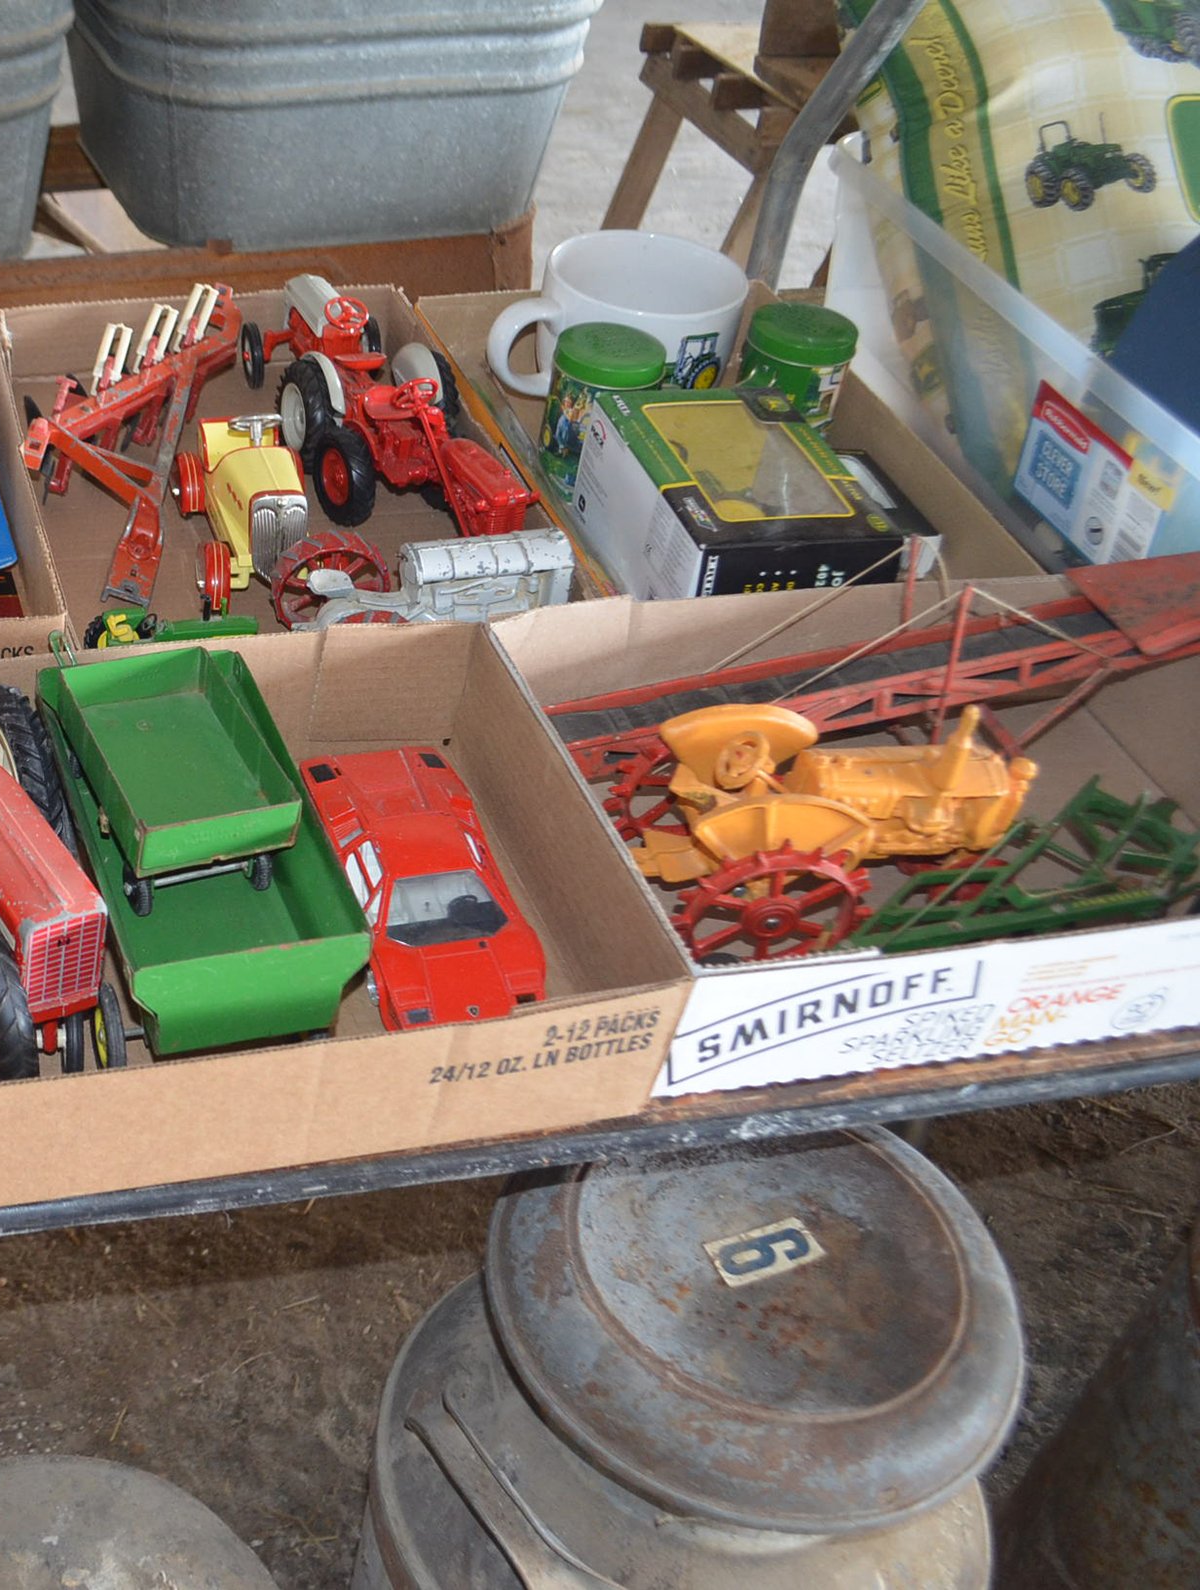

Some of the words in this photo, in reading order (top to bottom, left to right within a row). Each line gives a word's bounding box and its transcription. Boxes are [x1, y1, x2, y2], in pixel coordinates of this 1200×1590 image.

[944, 117, 964, 139] a
[939, 143, 977, 205] Like
[961, 209, 988, 263] uns
[1041, 440, 1074, 476] CLEVER
[1034, 462, 1068, 499] STORE
[697, 966, 953, 1063] SMIRNOFF
[1007, 983, 1126, 1014] ORANGE
[543, 1018, 591, 1047] 2-12
[593, 1007, 661, 1038] PACKS
[429, 1061, 492, 1085] 24/12
[496, 1055, 528, 1077] OZ.
[531, 1049, 560, 1070] LN
[564, 1032, 653, 1064] BOTTLES
